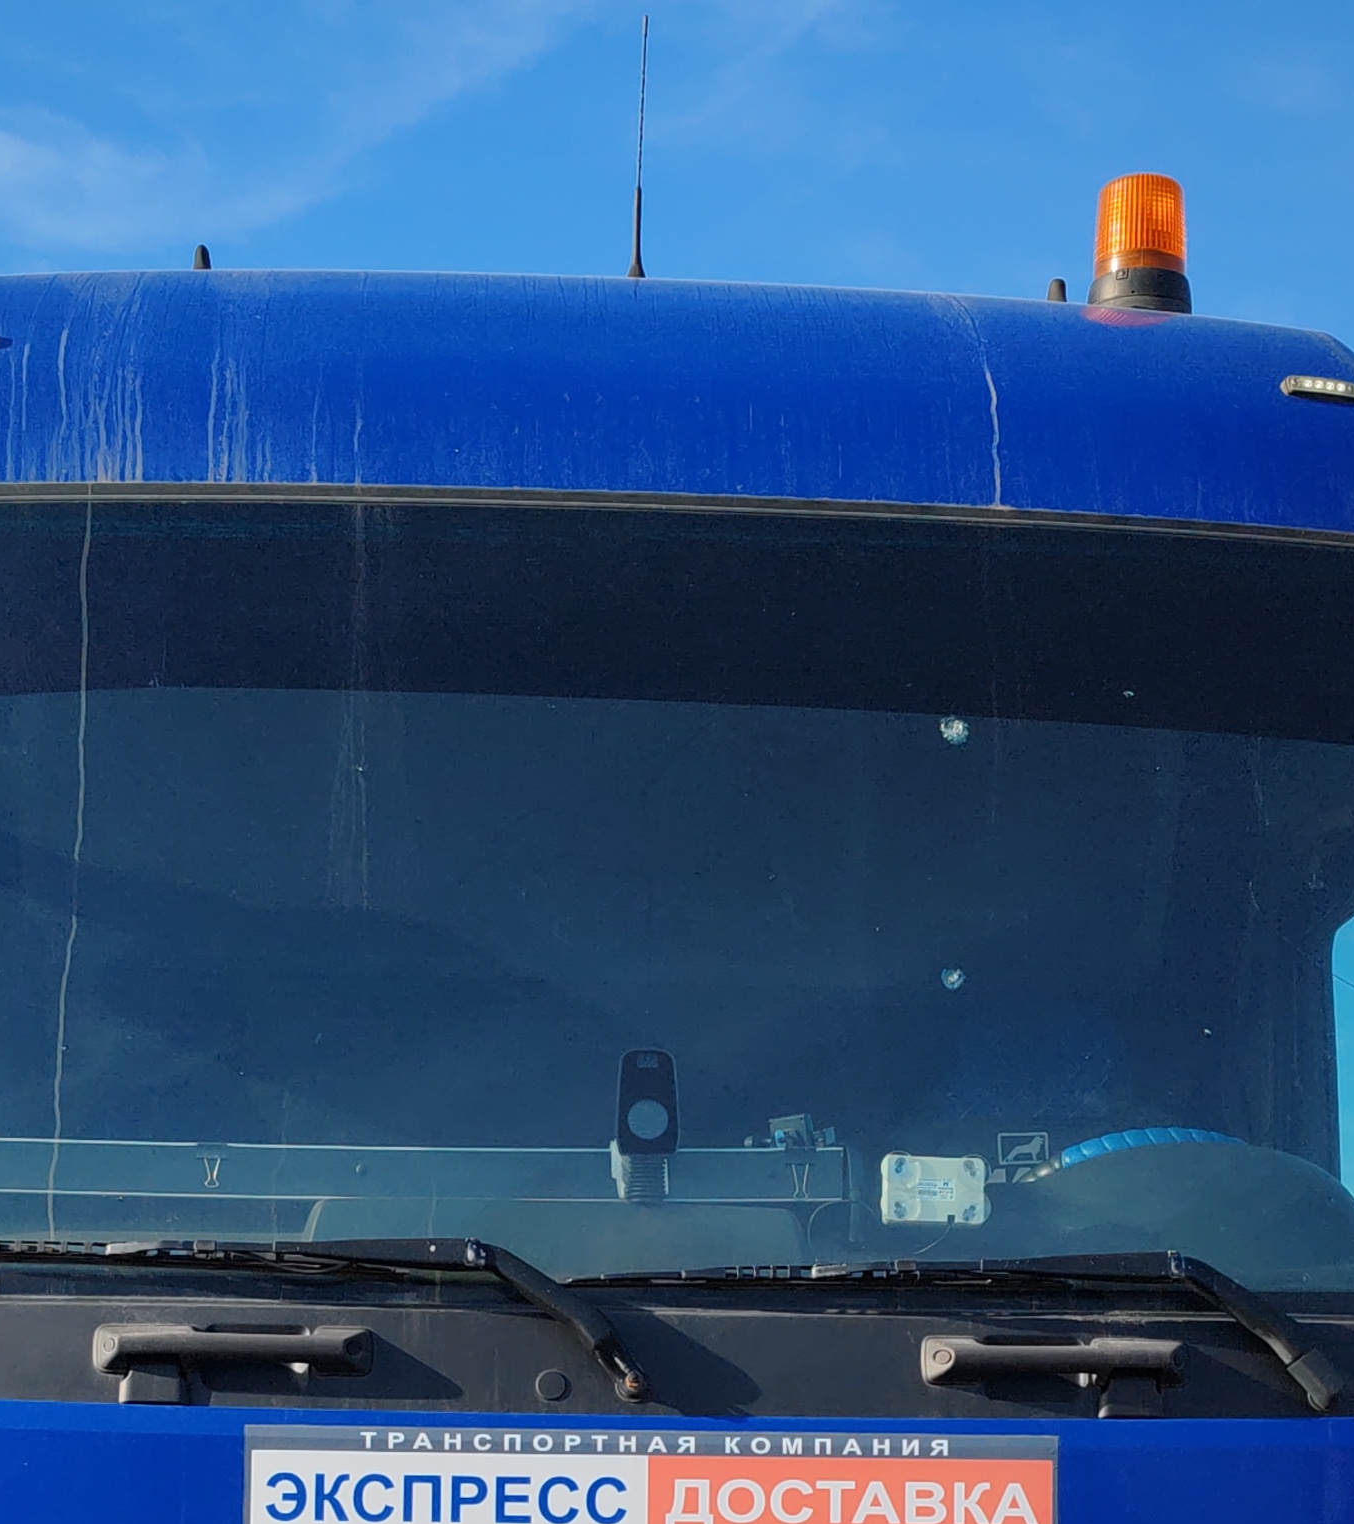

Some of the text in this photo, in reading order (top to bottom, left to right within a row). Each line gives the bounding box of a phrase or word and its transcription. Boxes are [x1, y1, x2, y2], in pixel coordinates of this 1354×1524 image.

[359, 1430, 950, 1457] ТРАНСПОРТНАЯ КОМПАНИЯ
[265, 1472, 628, 1524] ЭКСПРЕСС
